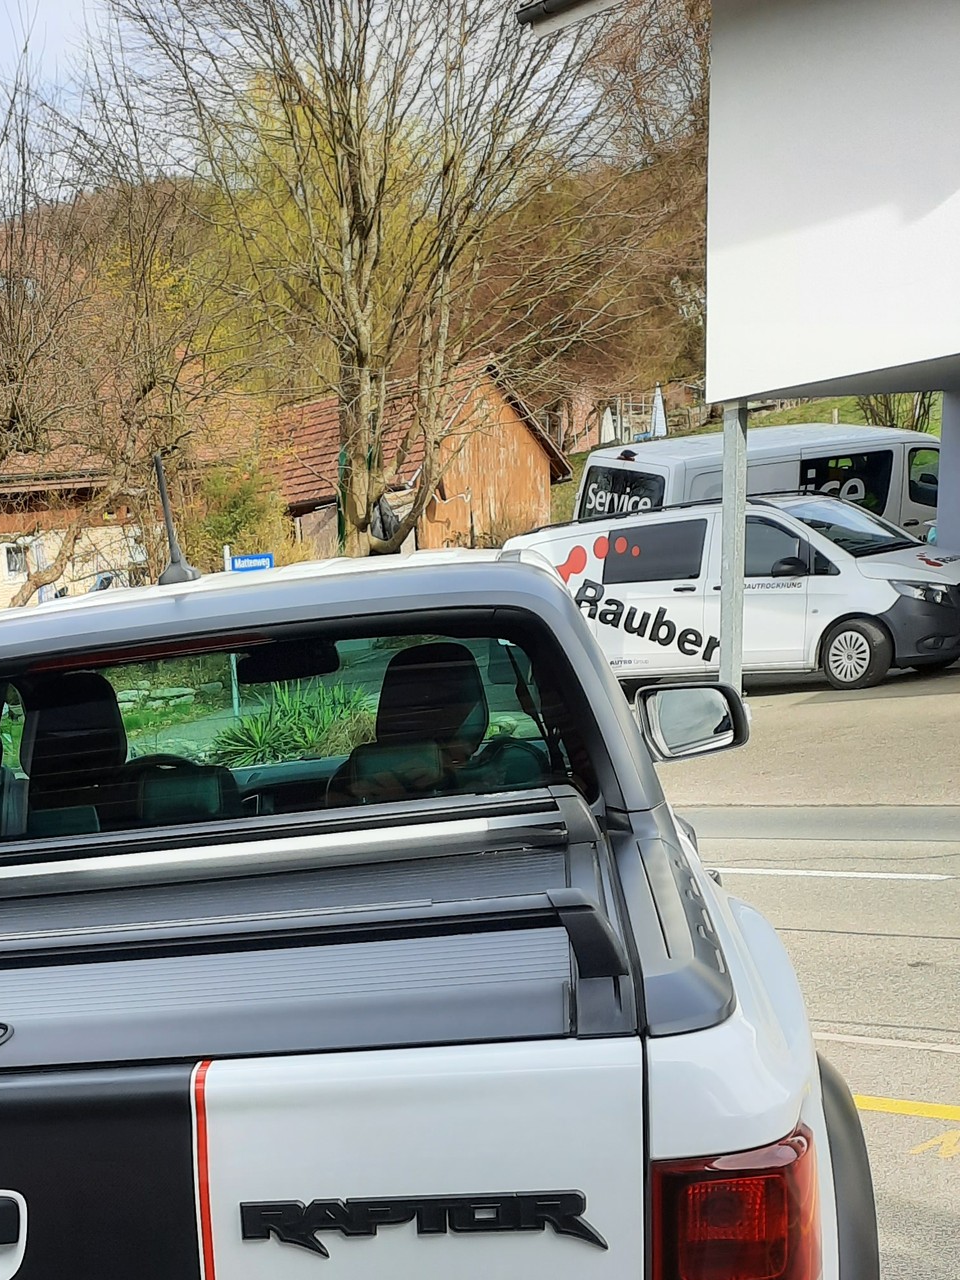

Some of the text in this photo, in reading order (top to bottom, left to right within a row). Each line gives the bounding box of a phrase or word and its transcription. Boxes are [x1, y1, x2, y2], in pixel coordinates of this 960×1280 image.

[585, 483, 652, 513] Service
[234, 557, 270, 570] Mattenweg
[574, 578, 721, 662] Rauber
[239, 1189, 608, 1259] RAPTOR
